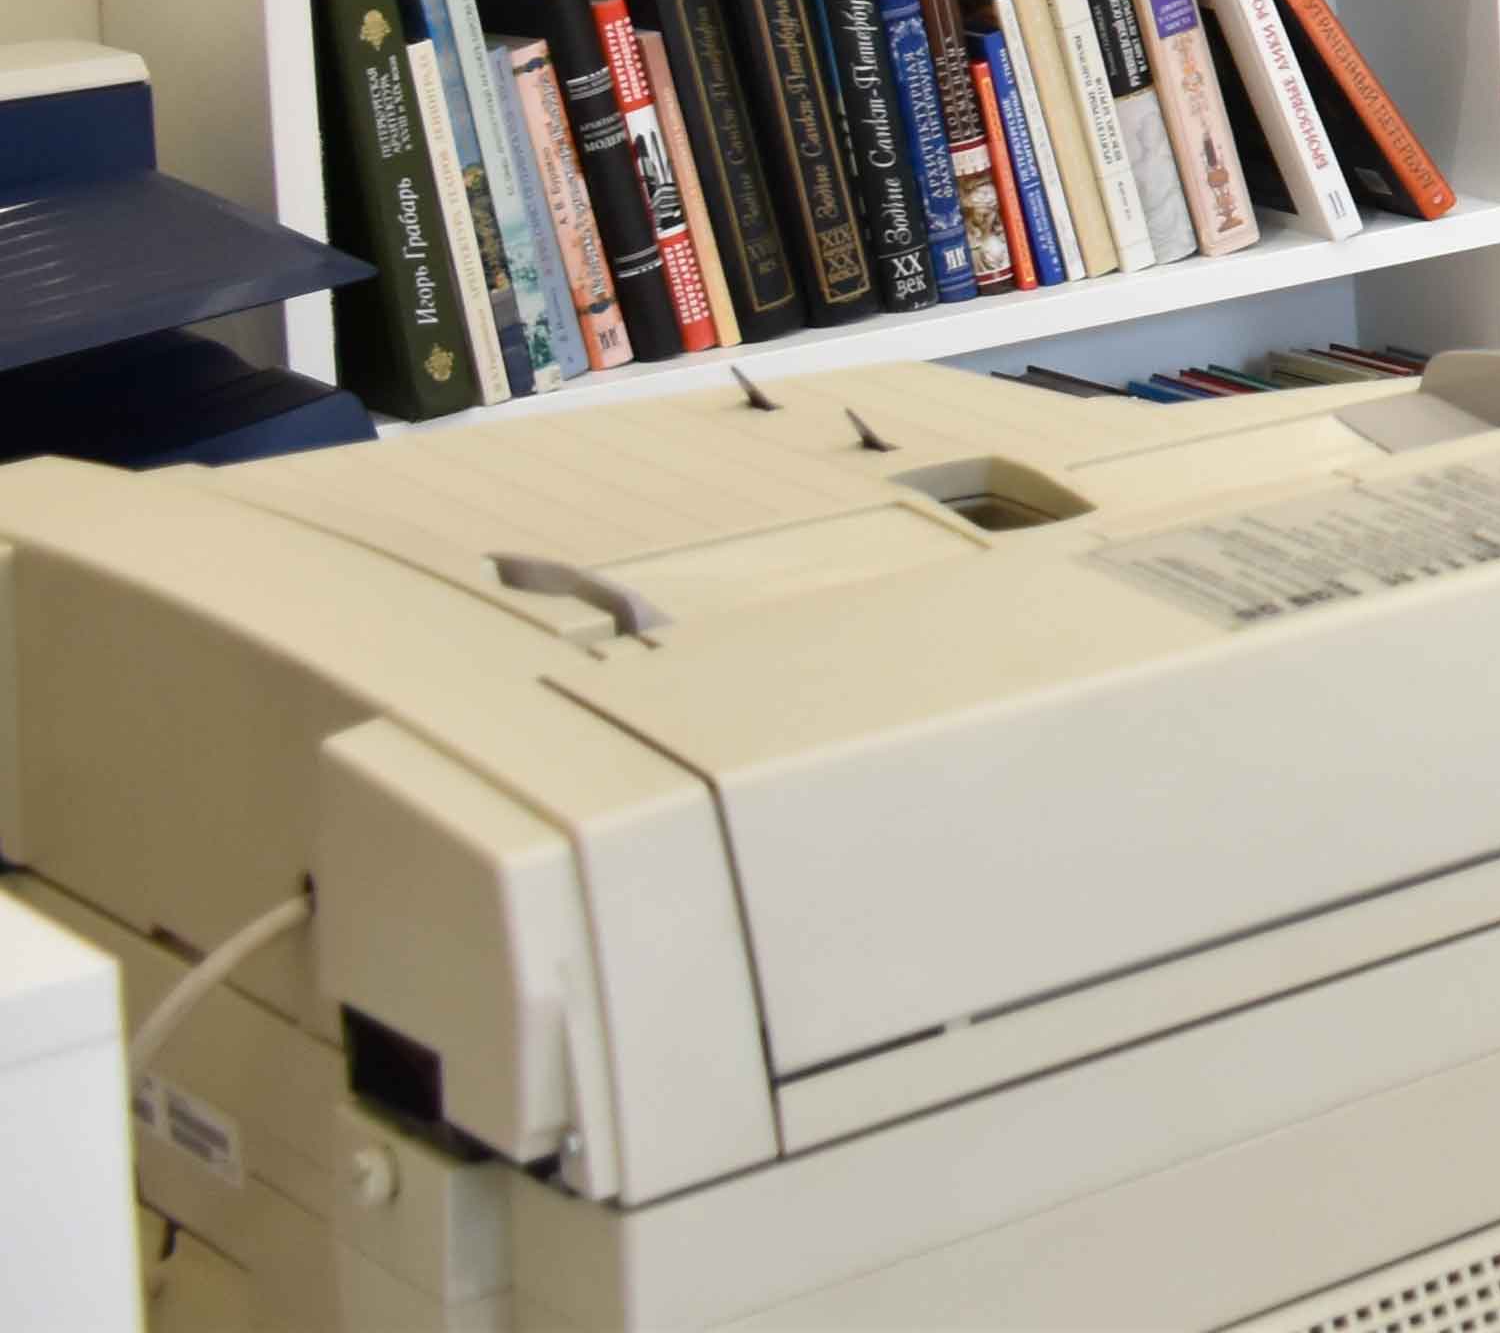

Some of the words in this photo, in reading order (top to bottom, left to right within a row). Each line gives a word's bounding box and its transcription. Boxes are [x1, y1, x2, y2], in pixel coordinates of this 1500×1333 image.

[1259, 20, 1293, 74] ЛИКИ
[398, 177, 428, 259] Грабарь
[884, 178, 914, 245] Зодчие
[892, 251, 923, 277] XX
[896, 273, 926, 299] век
[416, 265, 439, 325] Игорь
